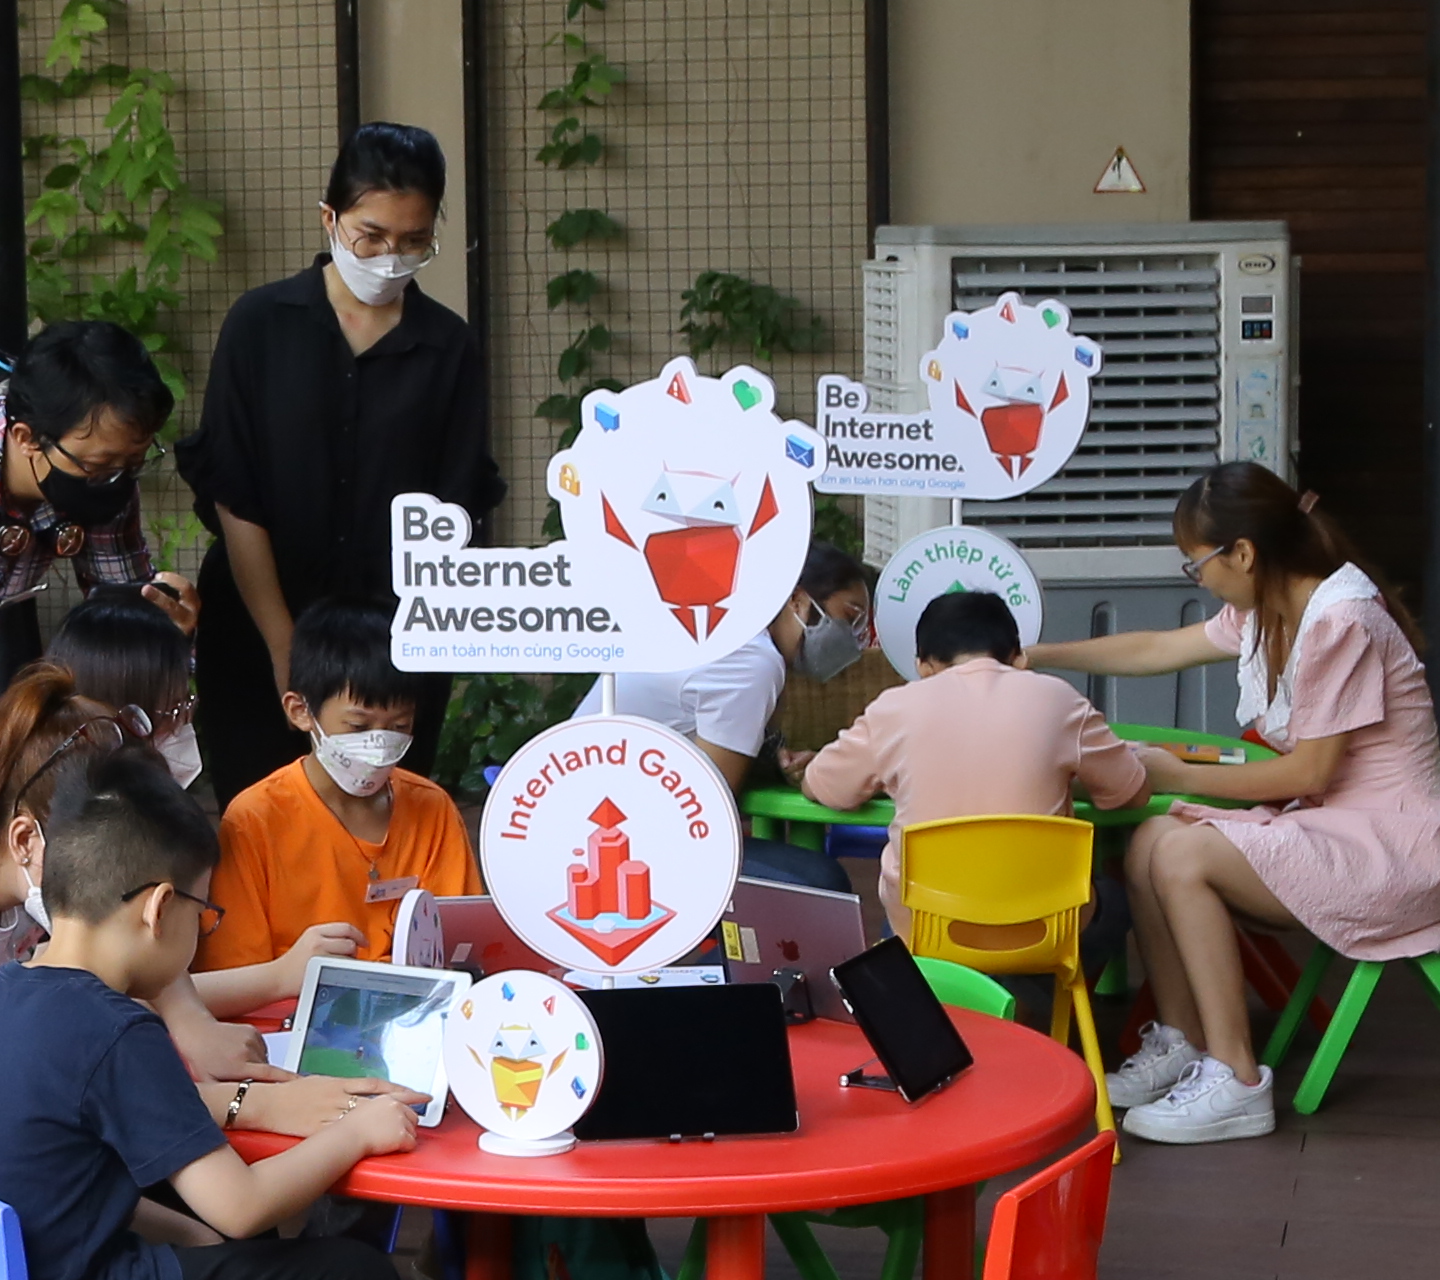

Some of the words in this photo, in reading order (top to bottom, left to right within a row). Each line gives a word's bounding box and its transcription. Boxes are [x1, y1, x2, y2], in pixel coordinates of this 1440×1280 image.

[826, 384, 860, 408] Be
[825, 414, 933, 441] Internet
[403, 506, 455, 541] Be
[404, 551, 571, 587] Internet
[888, 559, 925, 603] Làm
[924, 540, 984, 564] thiệp
[402, 643, 425, 657] Em
[429, 646, 447, 657] an
[452, 643, 486, 657] toàn
[490, 644, 520, 657] hơn
[523, 643, 562, 660] cùng
[567, 643, 624, 661] Google
[501, 738, 627, 840] Interland
[639, 748, 710, 840] Game
